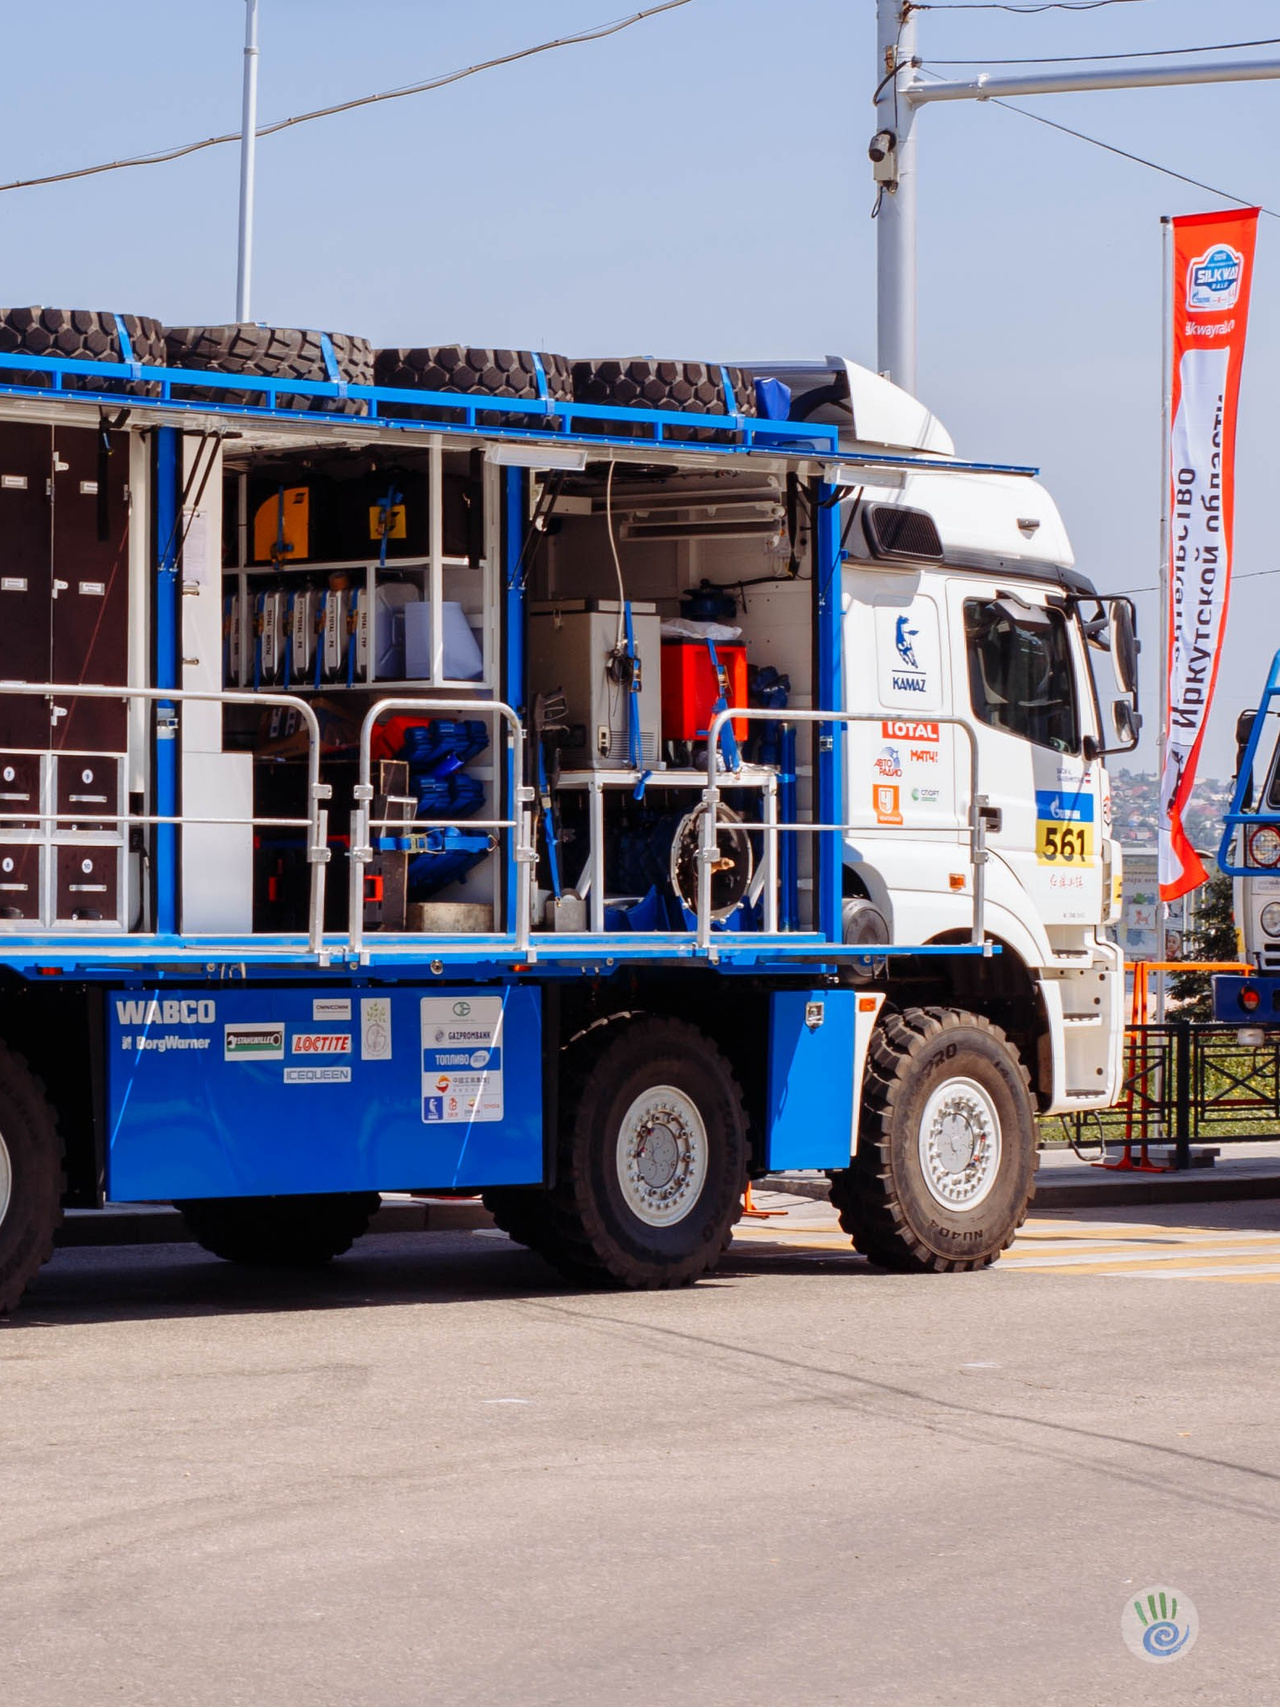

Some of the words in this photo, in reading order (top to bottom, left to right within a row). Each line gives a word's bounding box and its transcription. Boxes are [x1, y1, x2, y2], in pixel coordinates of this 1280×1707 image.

[893, 677, 926, 692] KAMAZ
[1042, 828, 1086, 862] 561
[116, 1000, 215, 1024] WABCO
[448, 1031, 491, 1040] GAZPROMBANK
[136, 1035, 211, 1052] BorgWarner
[294, 1036, 350, 1051] LOCTITE
[435, 1054, 470, 1065] ТОПЛИВО
[286, 1070, 349, 1081] ICEQUEEN
